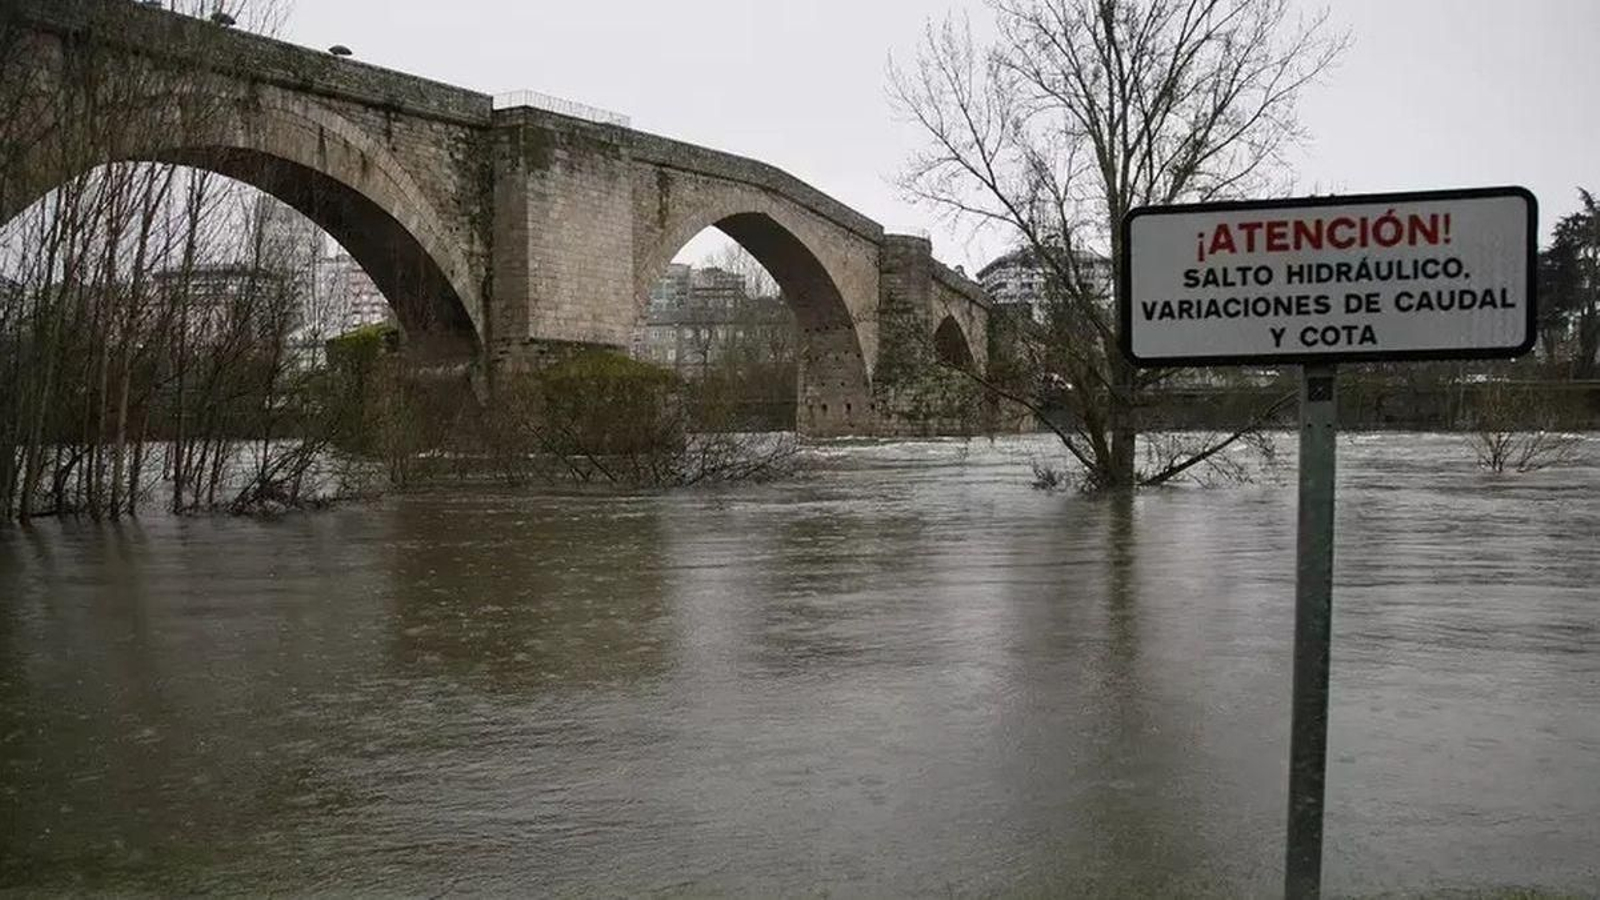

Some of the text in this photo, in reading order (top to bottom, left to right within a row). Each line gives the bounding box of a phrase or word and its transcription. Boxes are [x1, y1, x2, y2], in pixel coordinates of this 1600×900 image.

[1197, 208, 1451, 263] ¡ATENCIÓN!
[1183, 256, 1471, 289] SALTO HIDRÁULICO.
[1141, 286, 1517, 321] VARIACIONES DE CAUDAL
[1269, 324, 1378, 348] Y COTA
